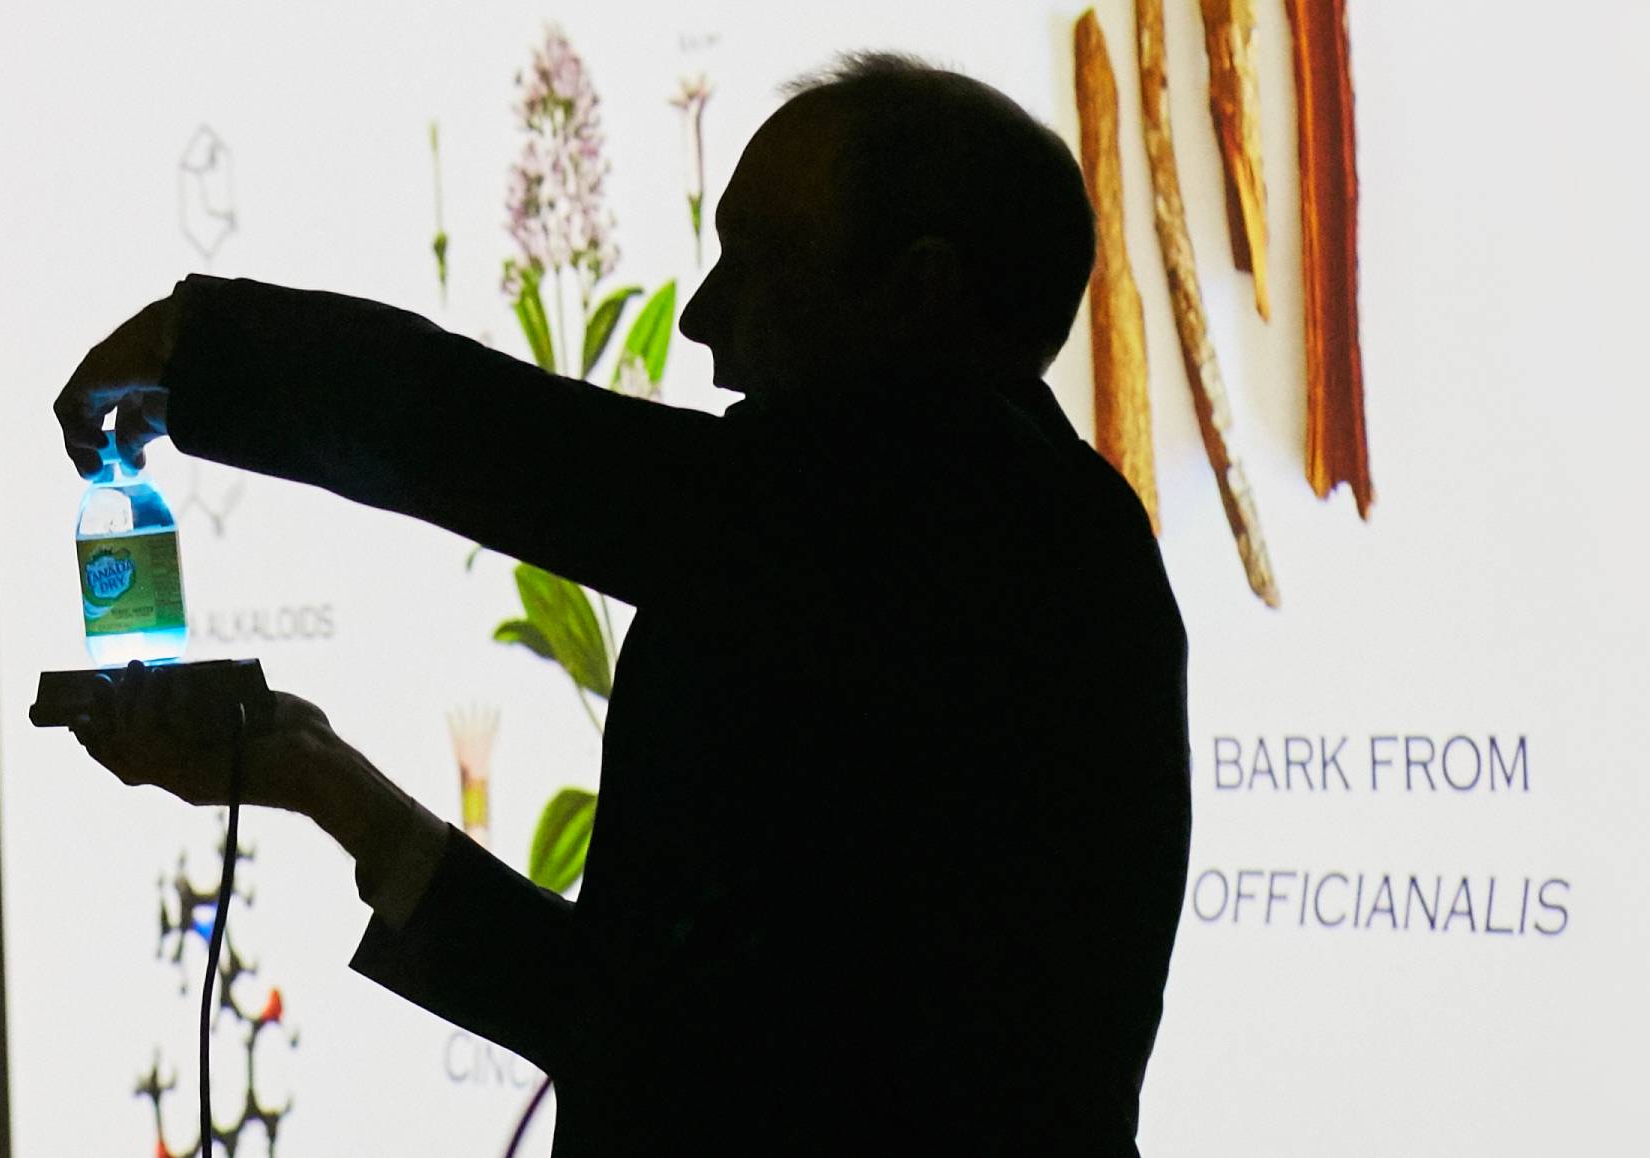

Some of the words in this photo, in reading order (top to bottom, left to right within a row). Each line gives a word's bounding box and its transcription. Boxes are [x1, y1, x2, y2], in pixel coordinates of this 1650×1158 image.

[86, 559, 135, 587] CANADA
[100, 574, 125, 593] DRY
[206, 604, 335, 644] ALKALOIDS
[1214, 736, 1350, 791] BARK
[1370, 734, 1529, 792] FROM
[1192, 869, 1570, 937] OFFICIANALIS
[443, 1030, 544, 1089] CINC
